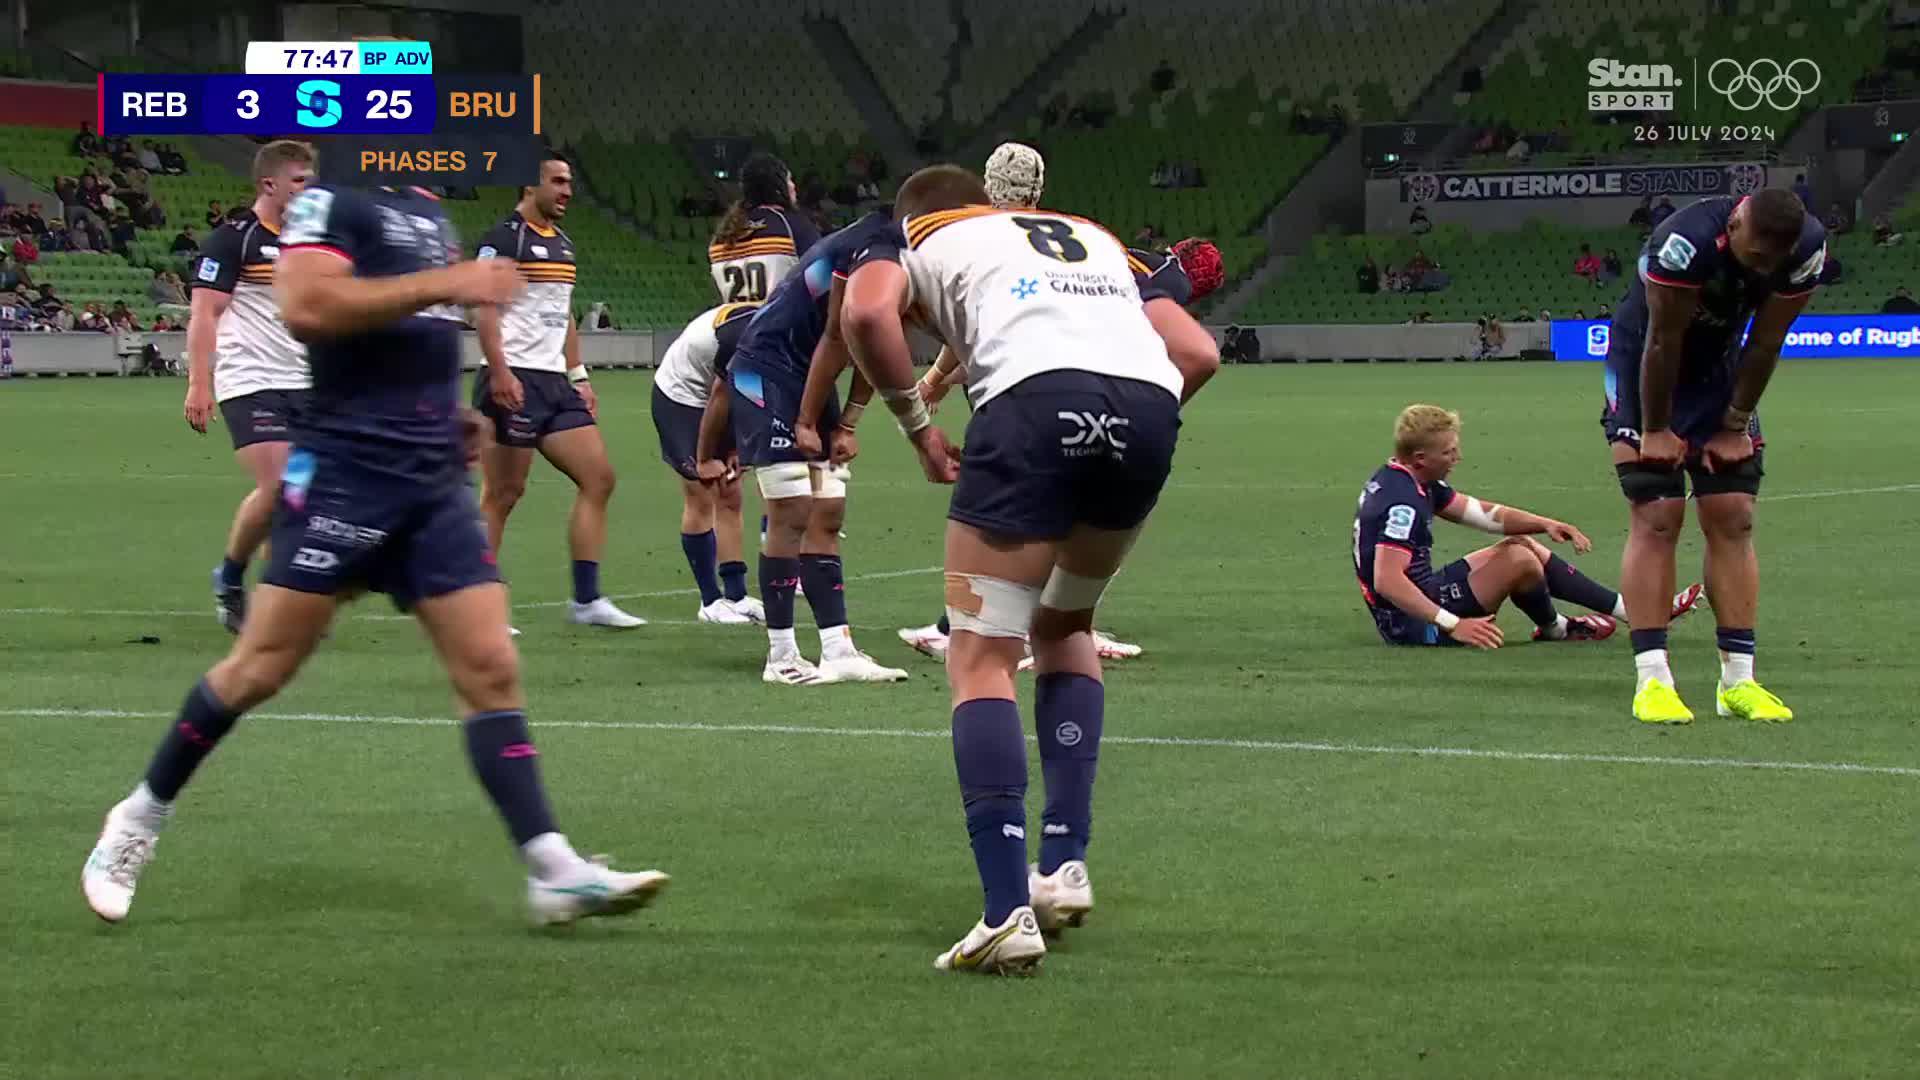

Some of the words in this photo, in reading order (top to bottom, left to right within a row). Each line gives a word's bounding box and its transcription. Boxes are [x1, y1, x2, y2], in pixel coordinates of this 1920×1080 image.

[1443, 173, 1622, 200] CATTERMOLE
[1626, 168, 1721, 194] STAND
[1011, 215, 1088, 263] 8
[724, 262, 767, 303] 20
[1785, 331, 1834, 346] ome
[1838, 327, 1863, 345] of
